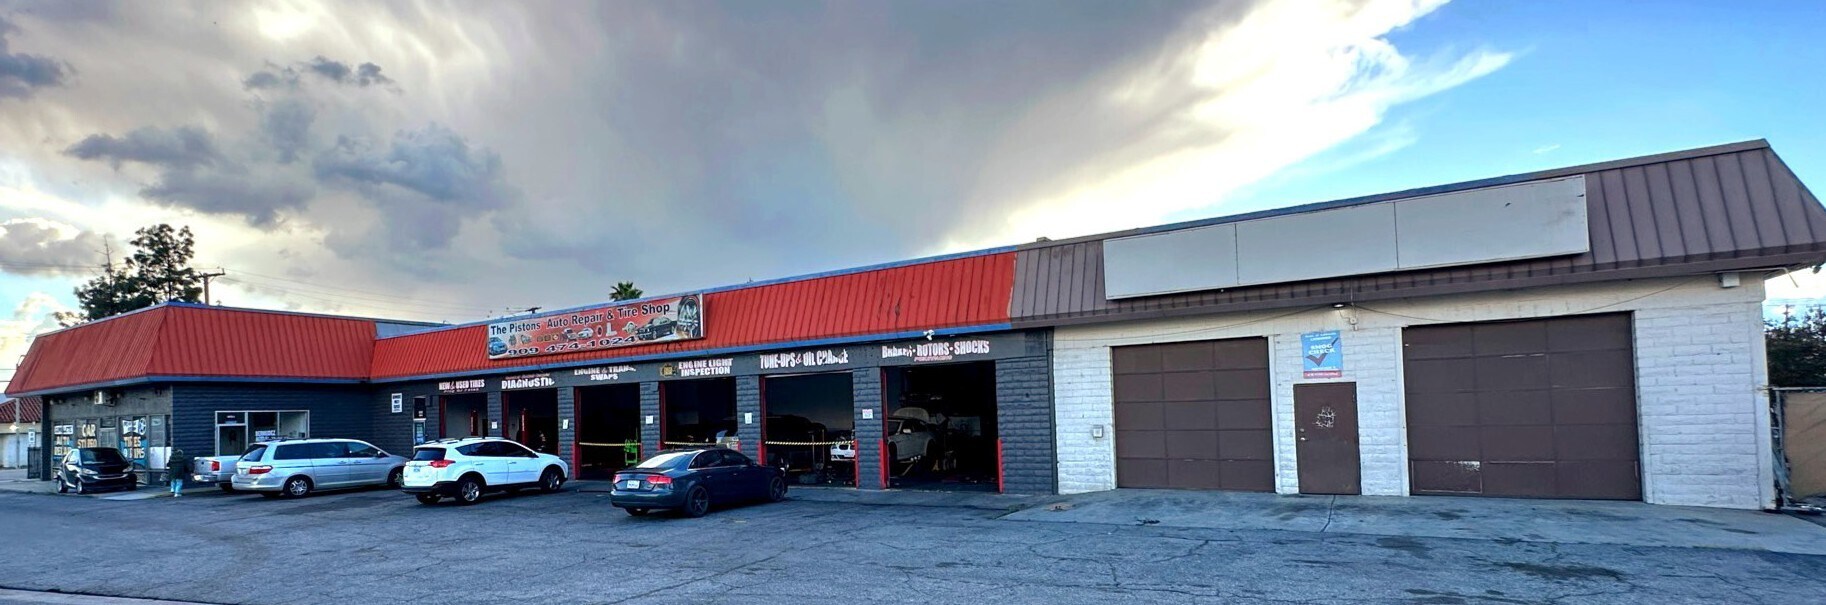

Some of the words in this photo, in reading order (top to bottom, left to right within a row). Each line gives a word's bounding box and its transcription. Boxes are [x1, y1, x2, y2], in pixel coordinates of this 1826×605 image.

[490, 325, 507, 335] The
[509, 322, 541, 333] Pistons
[547, 318, 569, 328] Auto
[571, 312, 603, 325] Repair
[606, 309, 614, 320] &
[617, 307, 638, 318] Tire
[641, 303, 670, 316] Shop
[508, 347, 540, 356] 909
[545, 335, 636, 352] 474-1024
[916, 341, 950, 357] ROTORS
[954, 340, 990, 355] SHOCKS
[678, 360, 707, 370] ENGINE
[708, 358, 733, 367] LIGHT
[803, 351, 816, 366] OIL
[590, 373, 619, 381] SWAPS
[680, 366, 731, 377] INSPECTION
[455, 380, 470, 389] USED
[470, 379, 485, 388] TIRES
[82, 424, 96, 437] CAR
